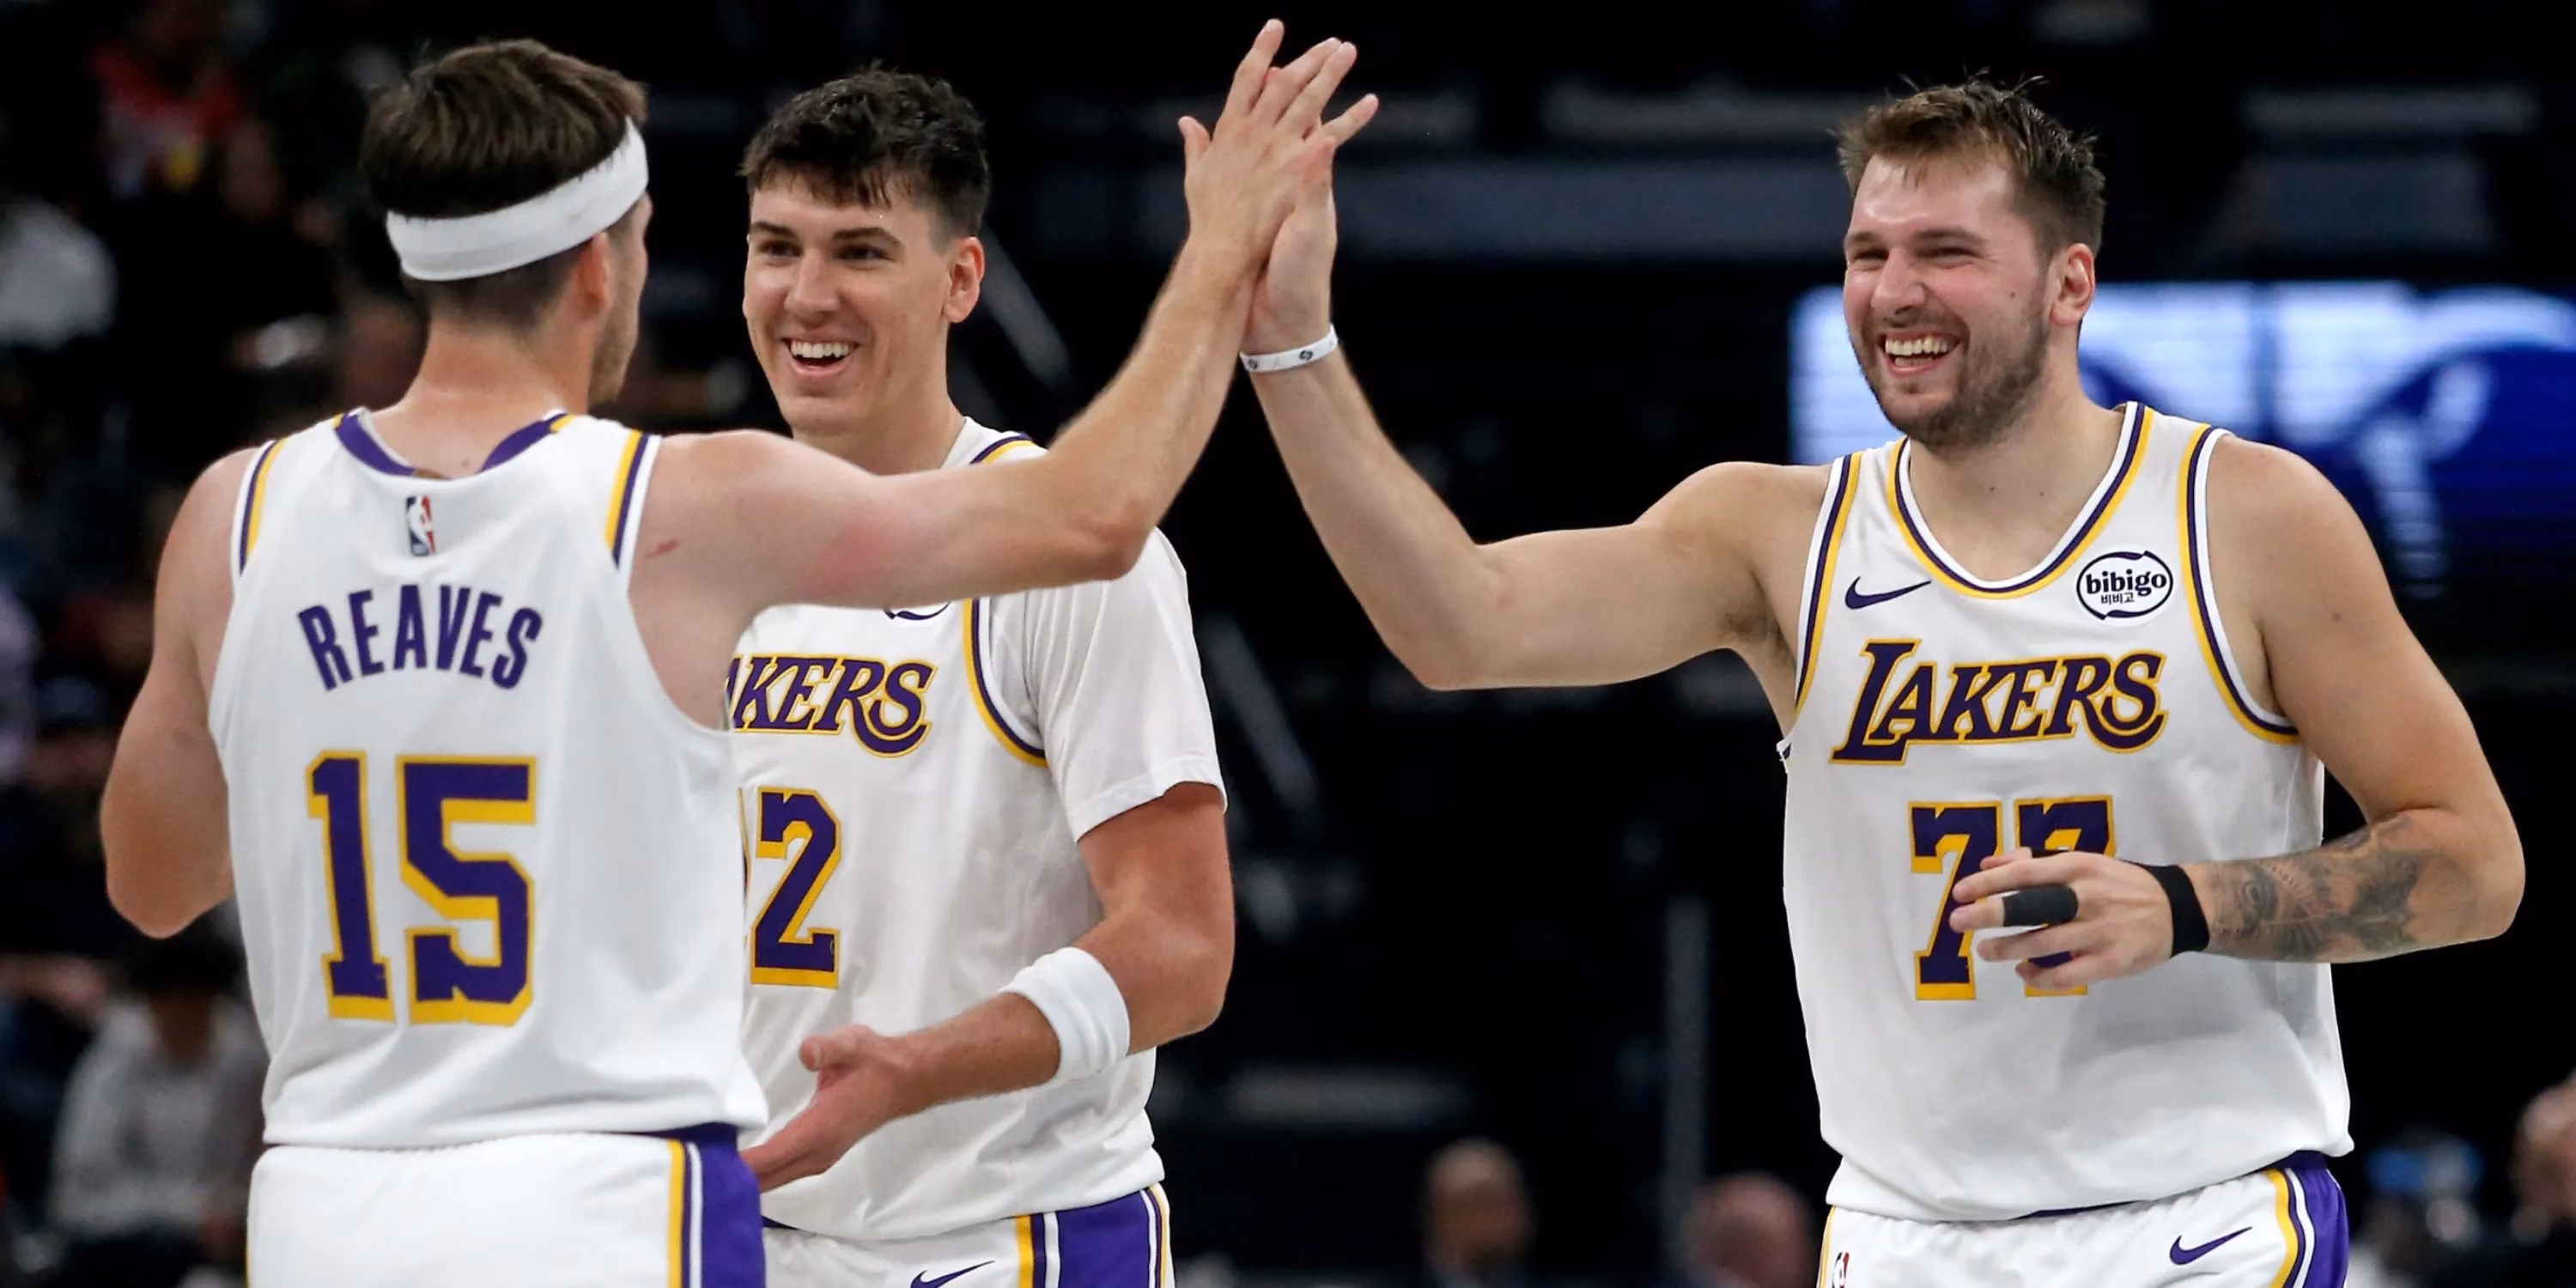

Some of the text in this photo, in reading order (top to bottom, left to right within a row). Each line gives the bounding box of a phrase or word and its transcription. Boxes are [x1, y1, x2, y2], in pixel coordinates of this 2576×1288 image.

[297, 584, 543, 690] REAVES
[2086, 568, 2167, 597] bibigo
[2100, 592, 2135, 605] 비비고
[1829, 638, 2168, 765] LAKERS
[305, 750, 537, 1027] 15
[738, 785, 841, 989] 2
[1908, 794, 2117, 1000] 77
